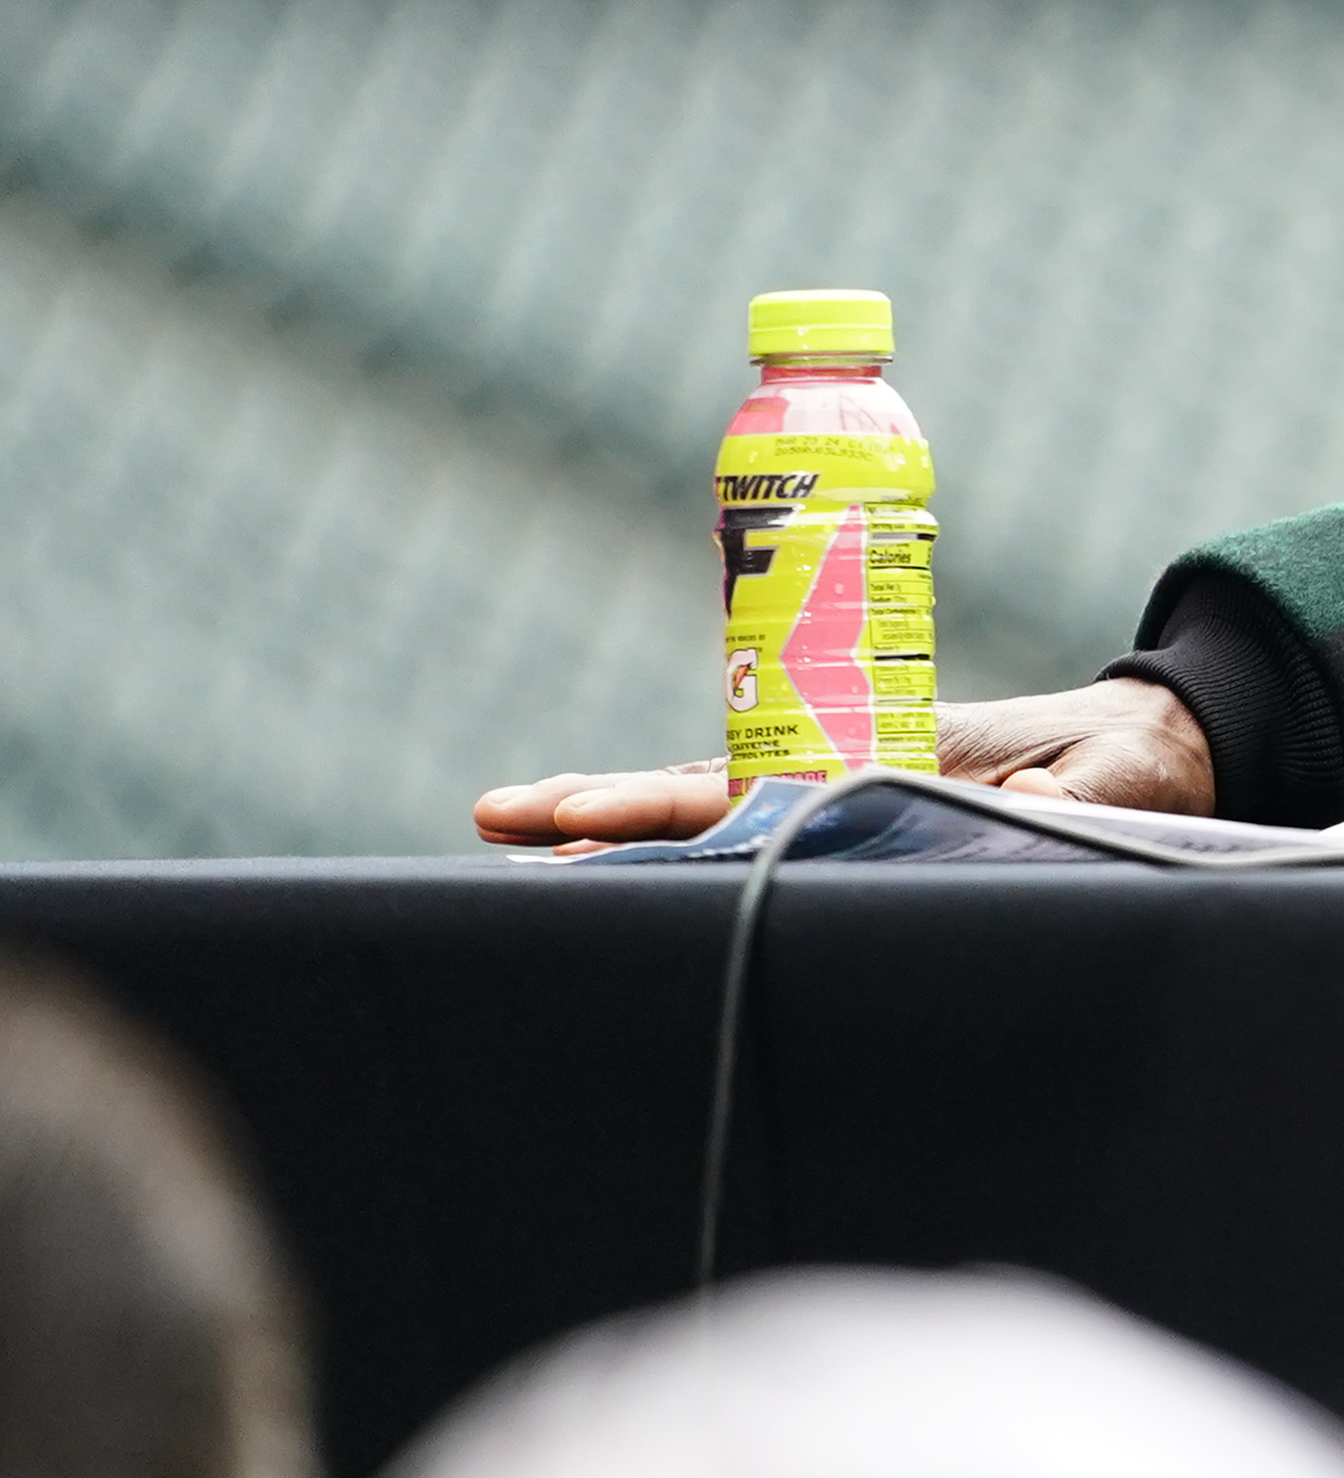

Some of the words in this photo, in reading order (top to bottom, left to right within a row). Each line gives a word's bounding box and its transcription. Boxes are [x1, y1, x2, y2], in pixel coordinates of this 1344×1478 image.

[723, 474, 818, 500] TWITCH
[870, 549, 911, 563] Calories
[726, 648, 759, 713] G
[745, 724, 799, 739] DRINK
